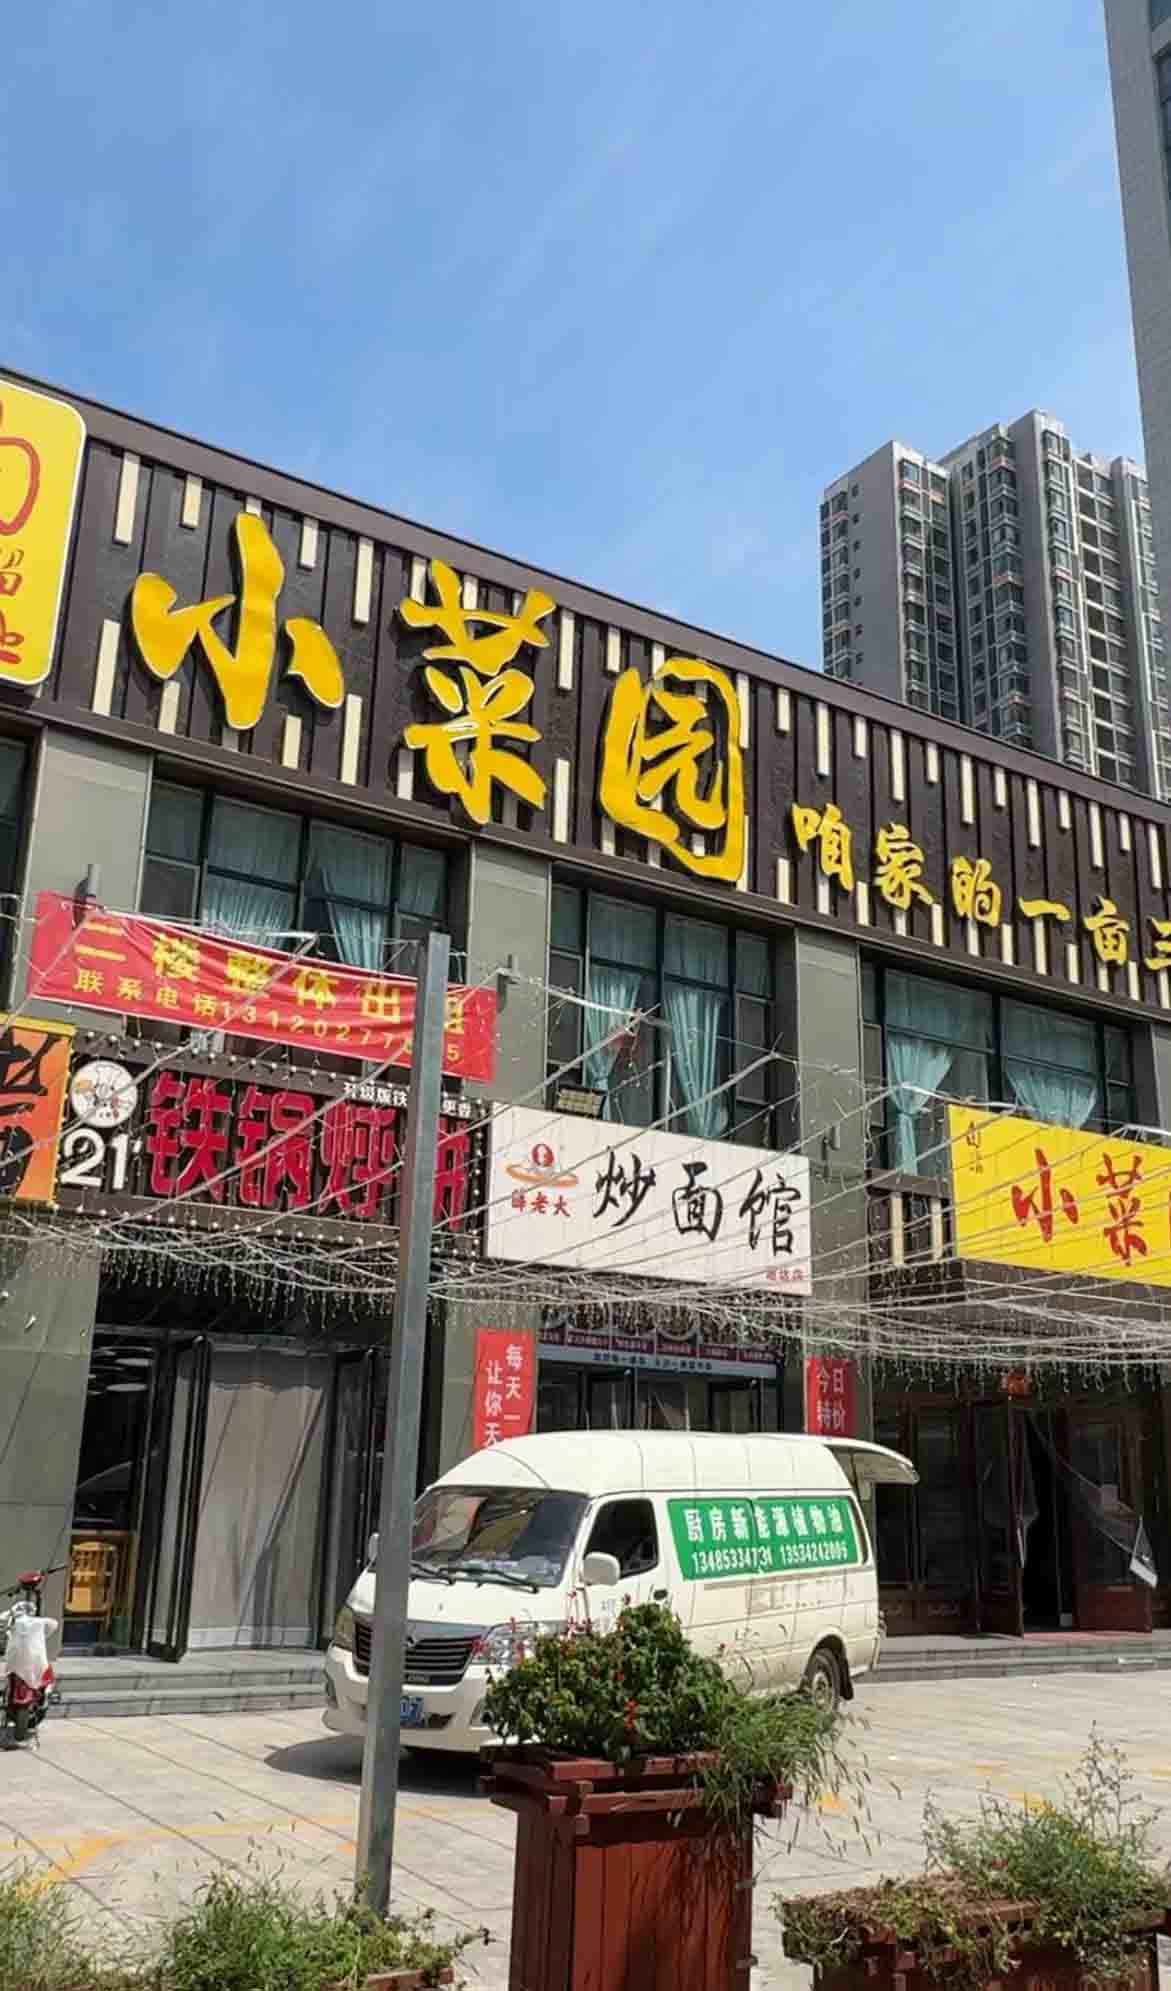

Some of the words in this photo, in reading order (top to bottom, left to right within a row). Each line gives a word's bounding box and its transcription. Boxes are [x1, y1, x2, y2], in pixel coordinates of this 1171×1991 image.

[130, 511, 745, 882] 小菜园
[72, 968, 461, 1063] 联系电话131202775
[593, 1145, 801, 1257] 炒面馆
[1011, 1148, 1171, 1266] 小菜
